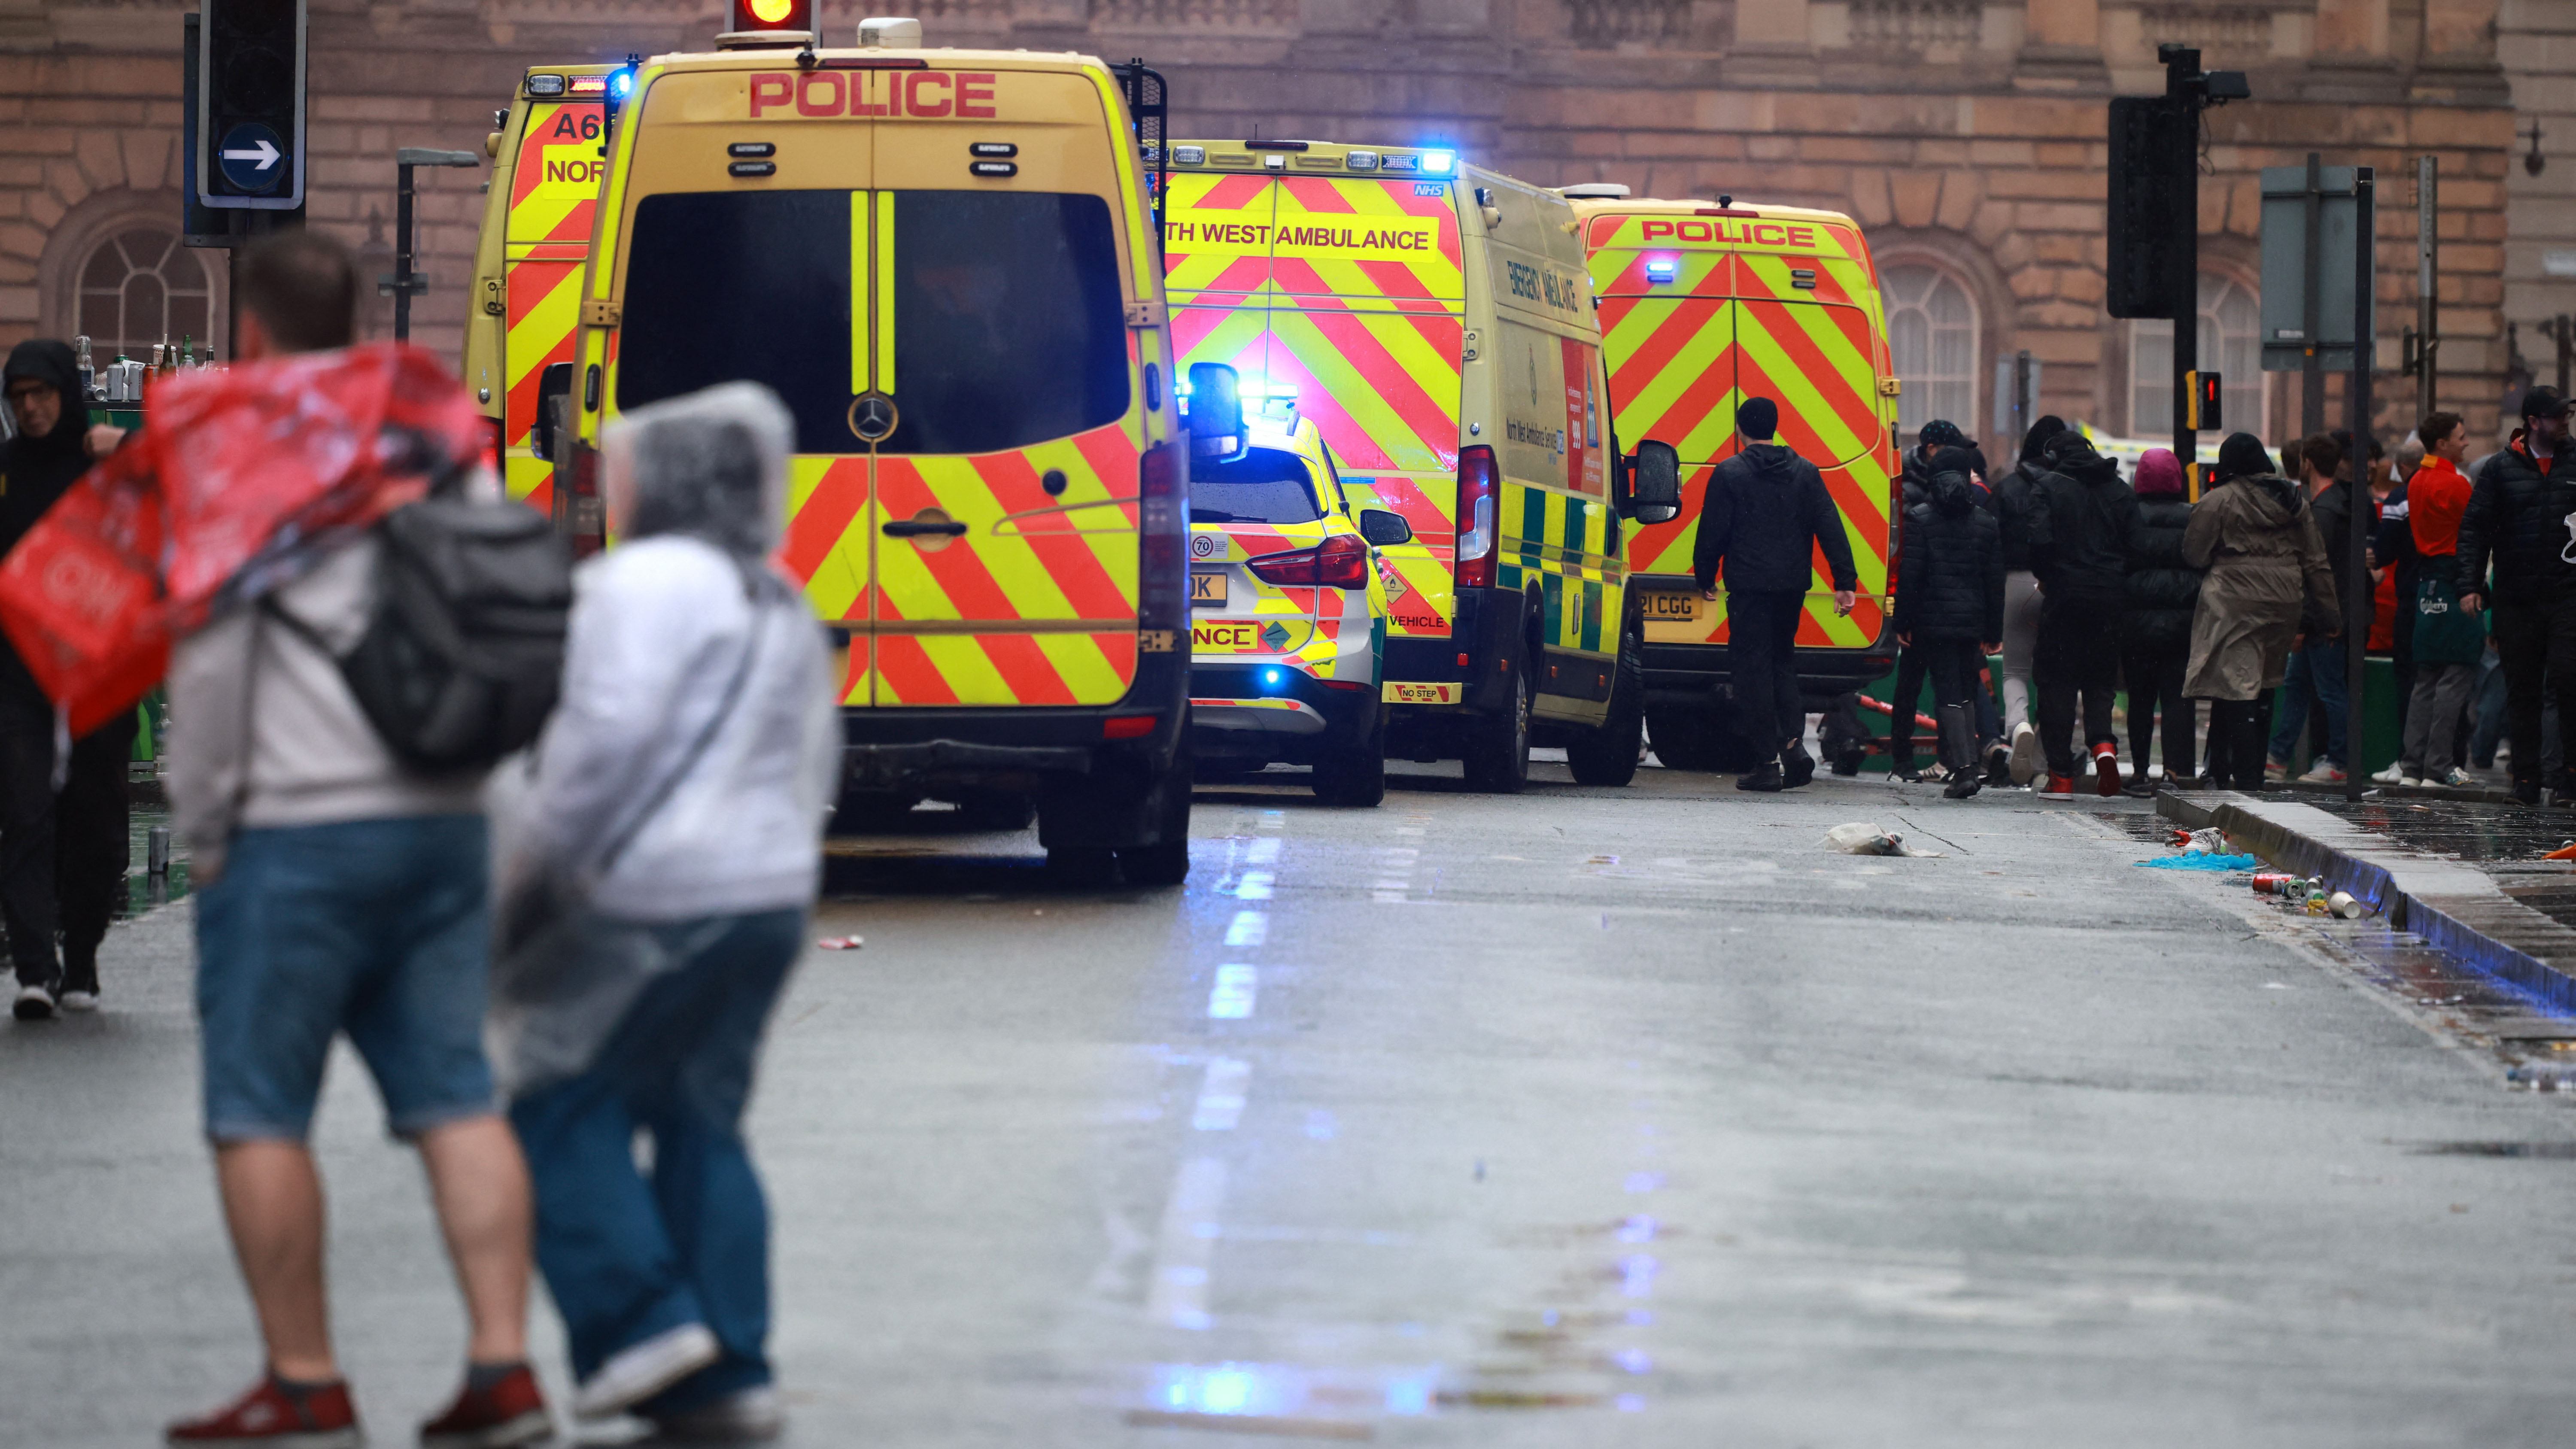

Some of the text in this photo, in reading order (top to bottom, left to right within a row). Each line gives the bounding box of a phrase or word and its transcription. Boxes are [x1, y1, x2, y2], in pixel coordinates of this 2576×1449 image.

[750, 72, 996, 118] POLICE
[1415, 185, 1443, 195] NHS
[1202, 223, 1270, 244] WEST
[1275, 226, 1428, 250] AMBULANCE
[1642, 221, 1816, 248] POLICE
[1507, 260, 1543, 303] EMERGENCY
[1572, 419, 1580, 449] 999
[1197, 542, 1209, 550] 70
[1658, 596, 1691, 614] CGG
[1389, 616, 1443, 627] VEHICLE
